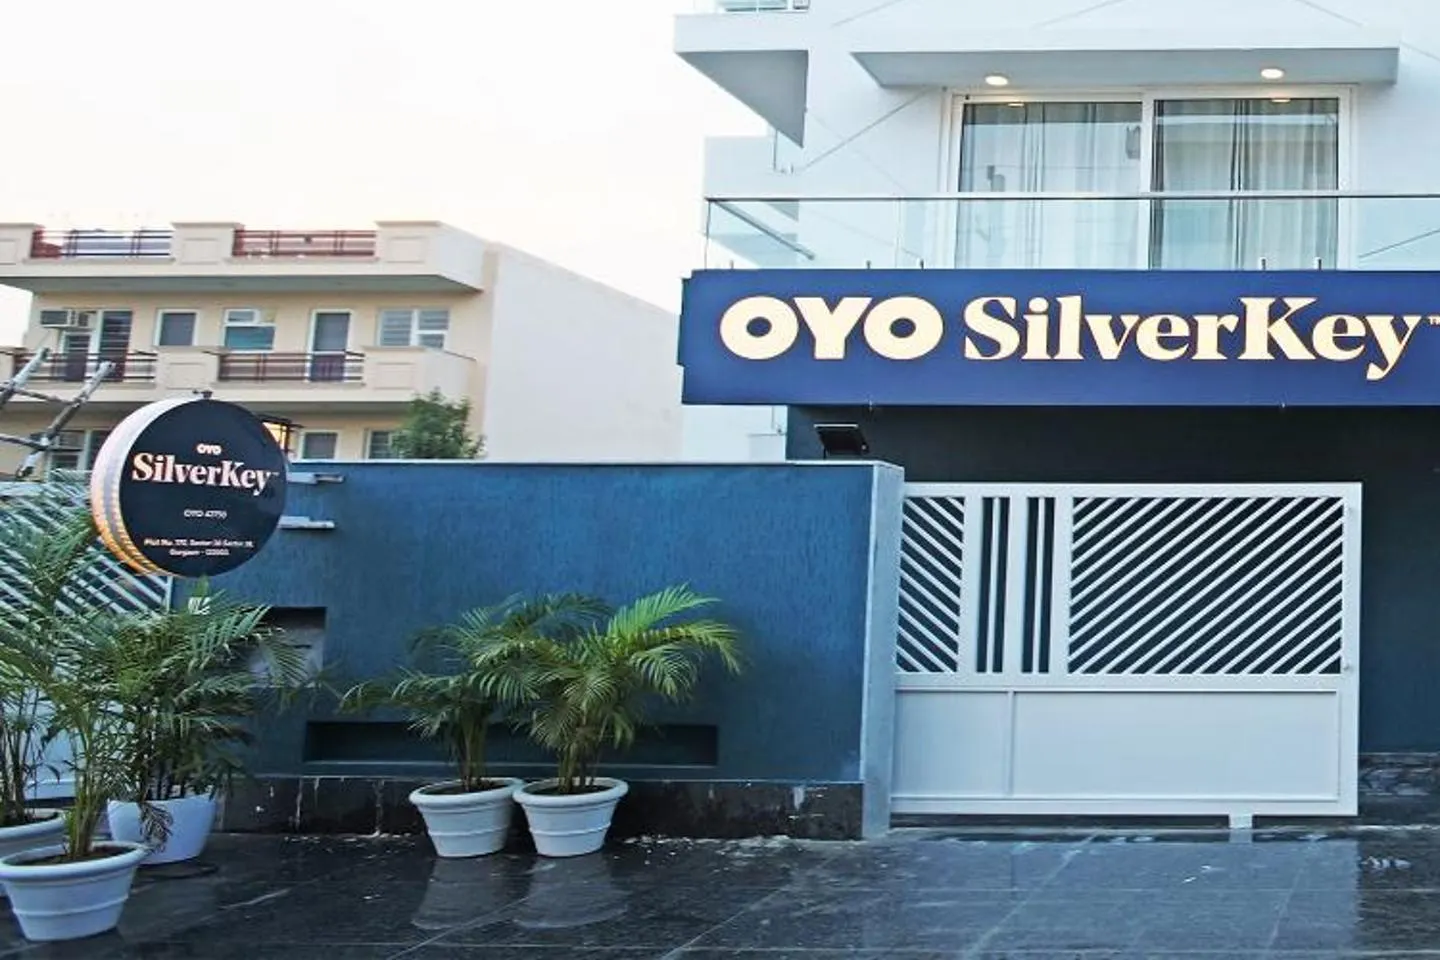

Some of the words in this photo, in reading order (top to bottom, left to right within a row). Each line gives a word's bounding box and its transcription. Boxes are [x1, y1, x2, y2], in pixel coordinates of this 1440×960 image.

[719, 295, 944, 361] OYO
[962, 295, 1419, 381] SilverKey
[197, 443, 222, 455] OYO
[132, 452, 271, 496] SilverKey
